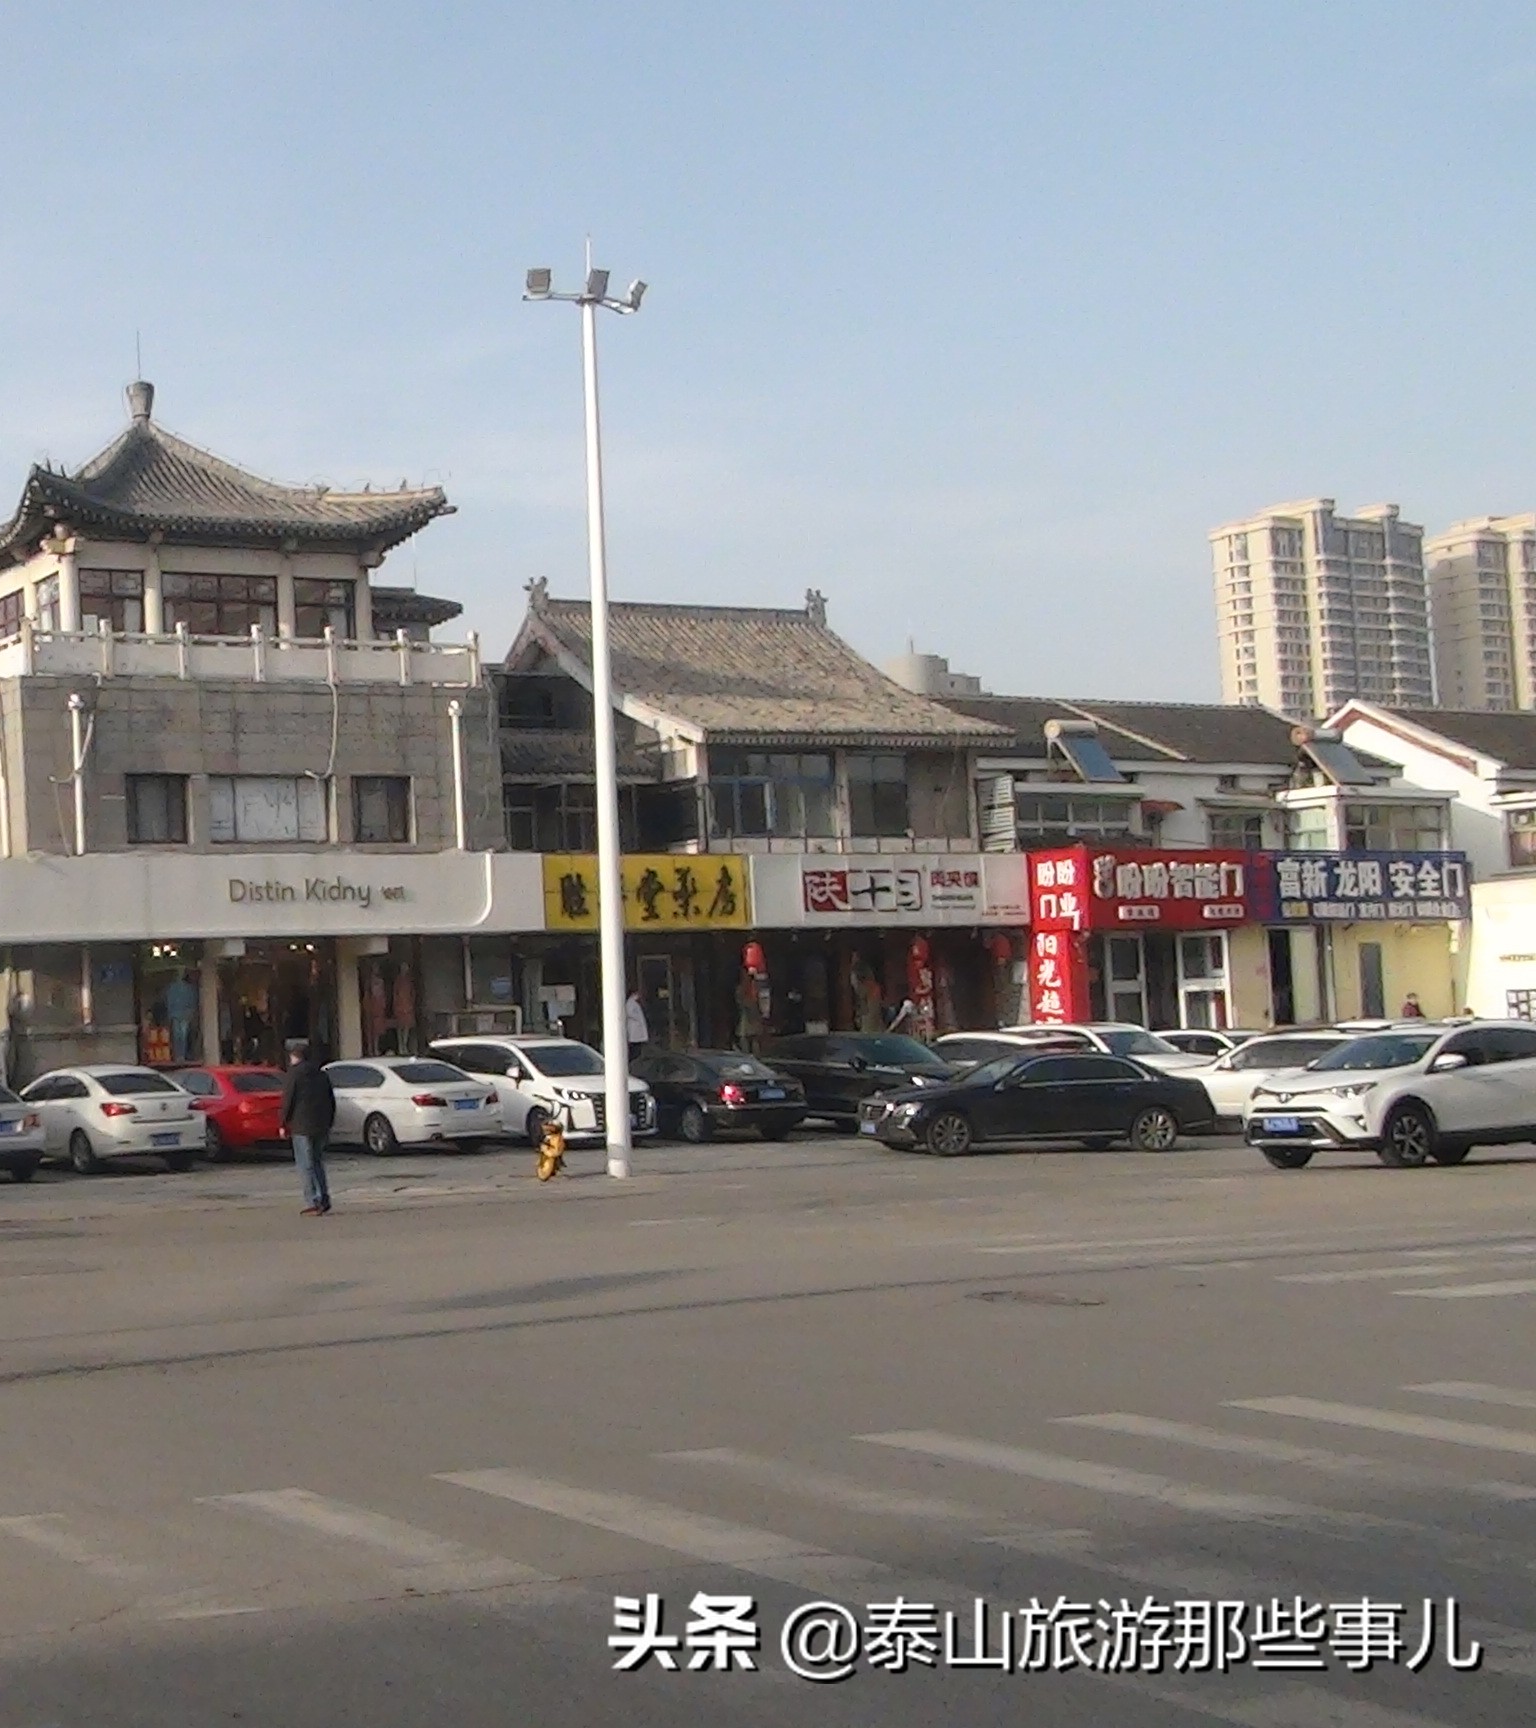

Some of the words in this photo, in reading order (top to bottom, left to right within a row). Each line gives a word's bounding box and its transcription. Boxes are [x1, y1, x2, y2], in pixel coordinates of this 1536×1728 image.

[800, 869, 924, 912] 陕十三
[1036, 859, 1075, 887] 盼盼
[1116, 862, 1245, 899] 盼盼智能门
[1388, 860, 1465, 898] 安全门
[228, 879, 295, 903] Distin
[304, 876, 371, 908] Kidny
[1040, 891, 1080, 931] 门业
